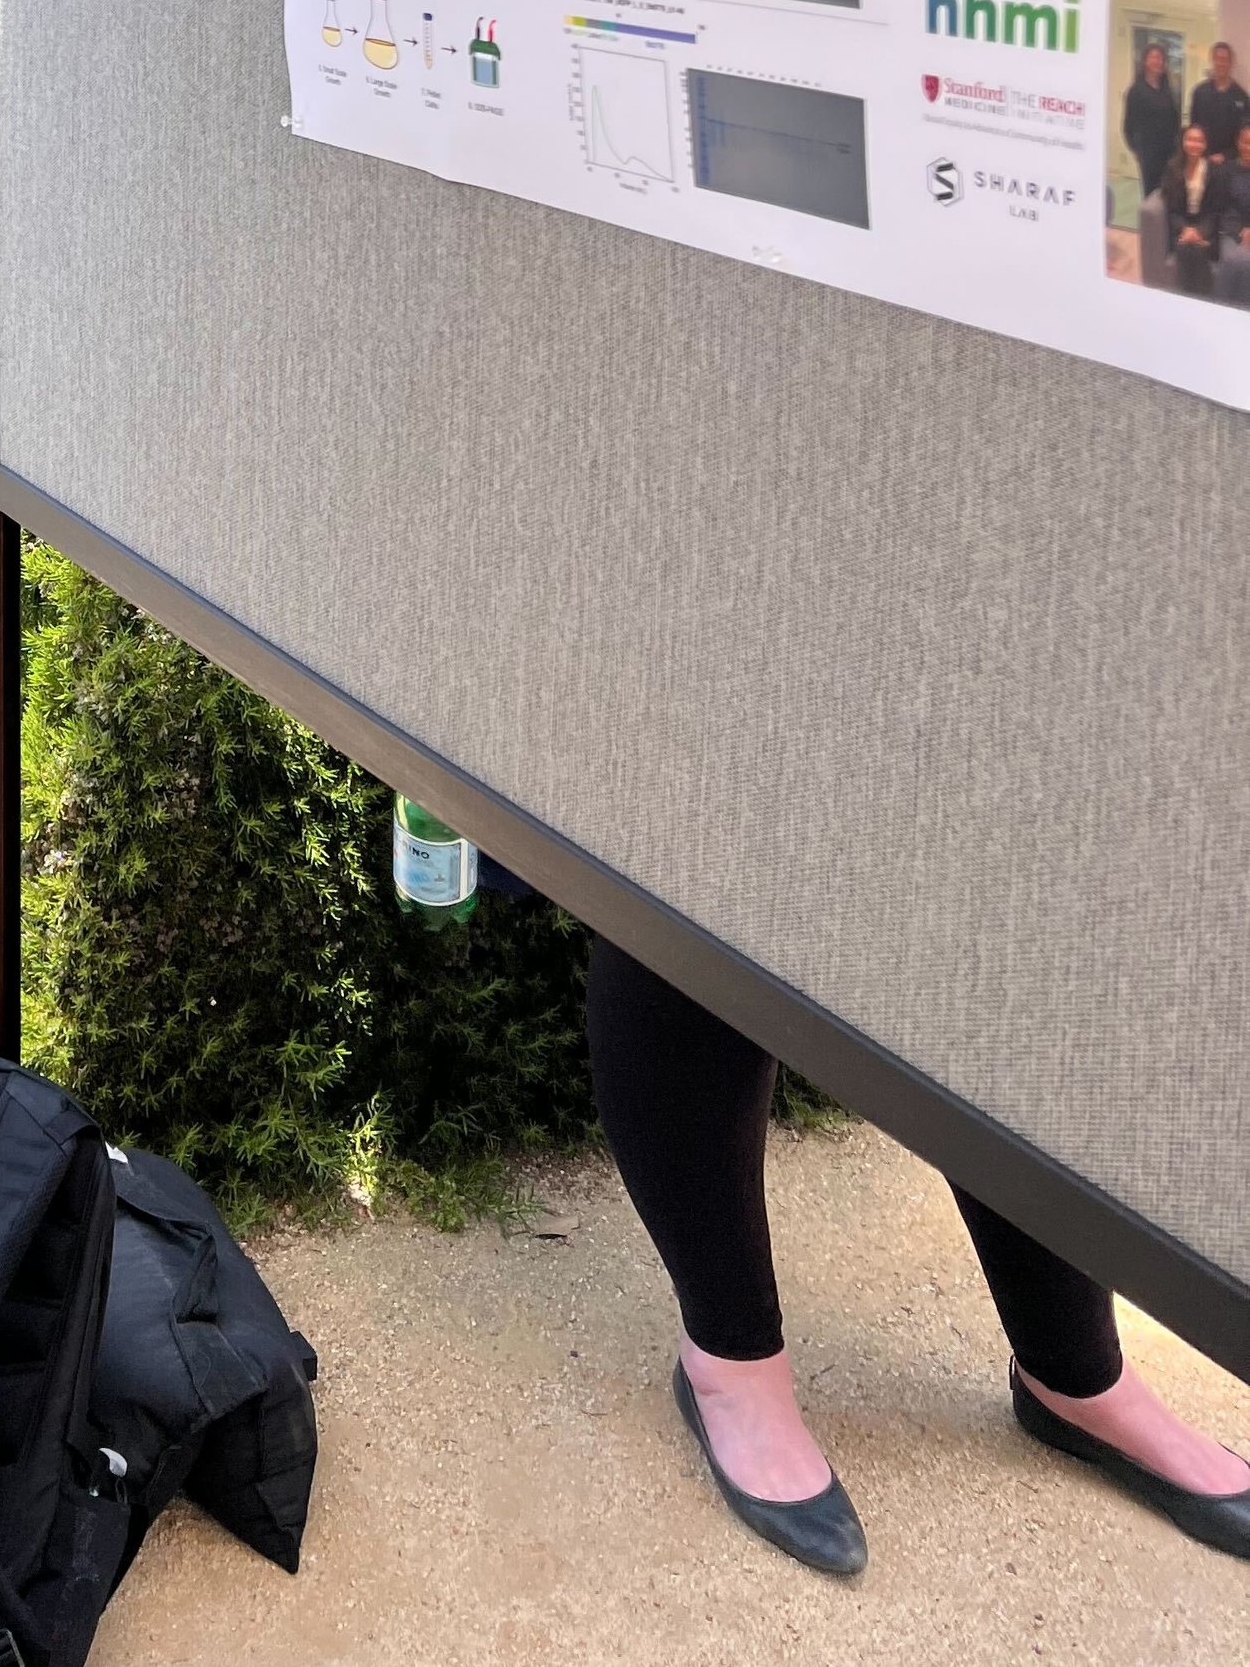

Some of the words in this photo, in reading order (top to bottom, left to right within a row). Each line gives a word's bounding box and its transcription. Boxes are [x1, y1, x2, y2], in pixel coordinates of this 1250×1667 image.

[944, 78, 1006, 103] Stanford
[1011, 90, 1036, 107] THE
[1038, 96, 1086, 116] REACH
[944, 97, 1007, 116] MEDICINE
[973, 171, 1076, 206] SHARAF
[1009, 205, 1039, 222] LAB
